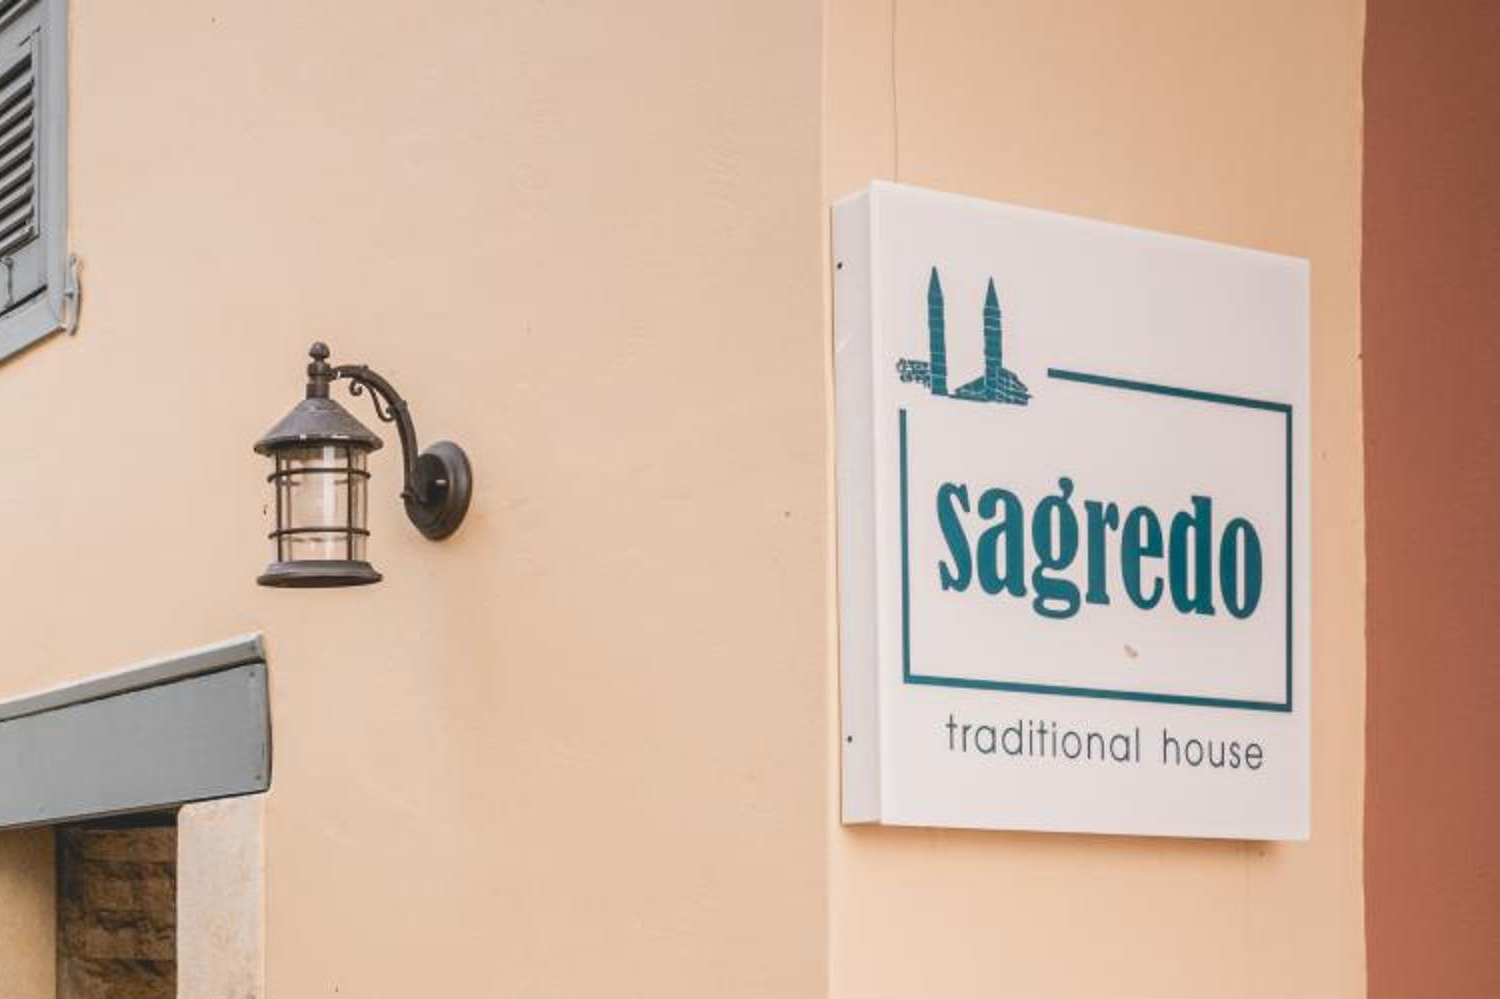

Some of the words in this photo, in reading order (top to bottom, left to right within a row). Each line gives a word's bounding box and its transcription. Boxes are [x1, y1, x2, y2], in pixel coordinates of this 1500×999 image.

[936, 477, 1263, 619] sagredo
[945, 714, 1140, 763] traditional
[1163, 728, 1263, 770] house
